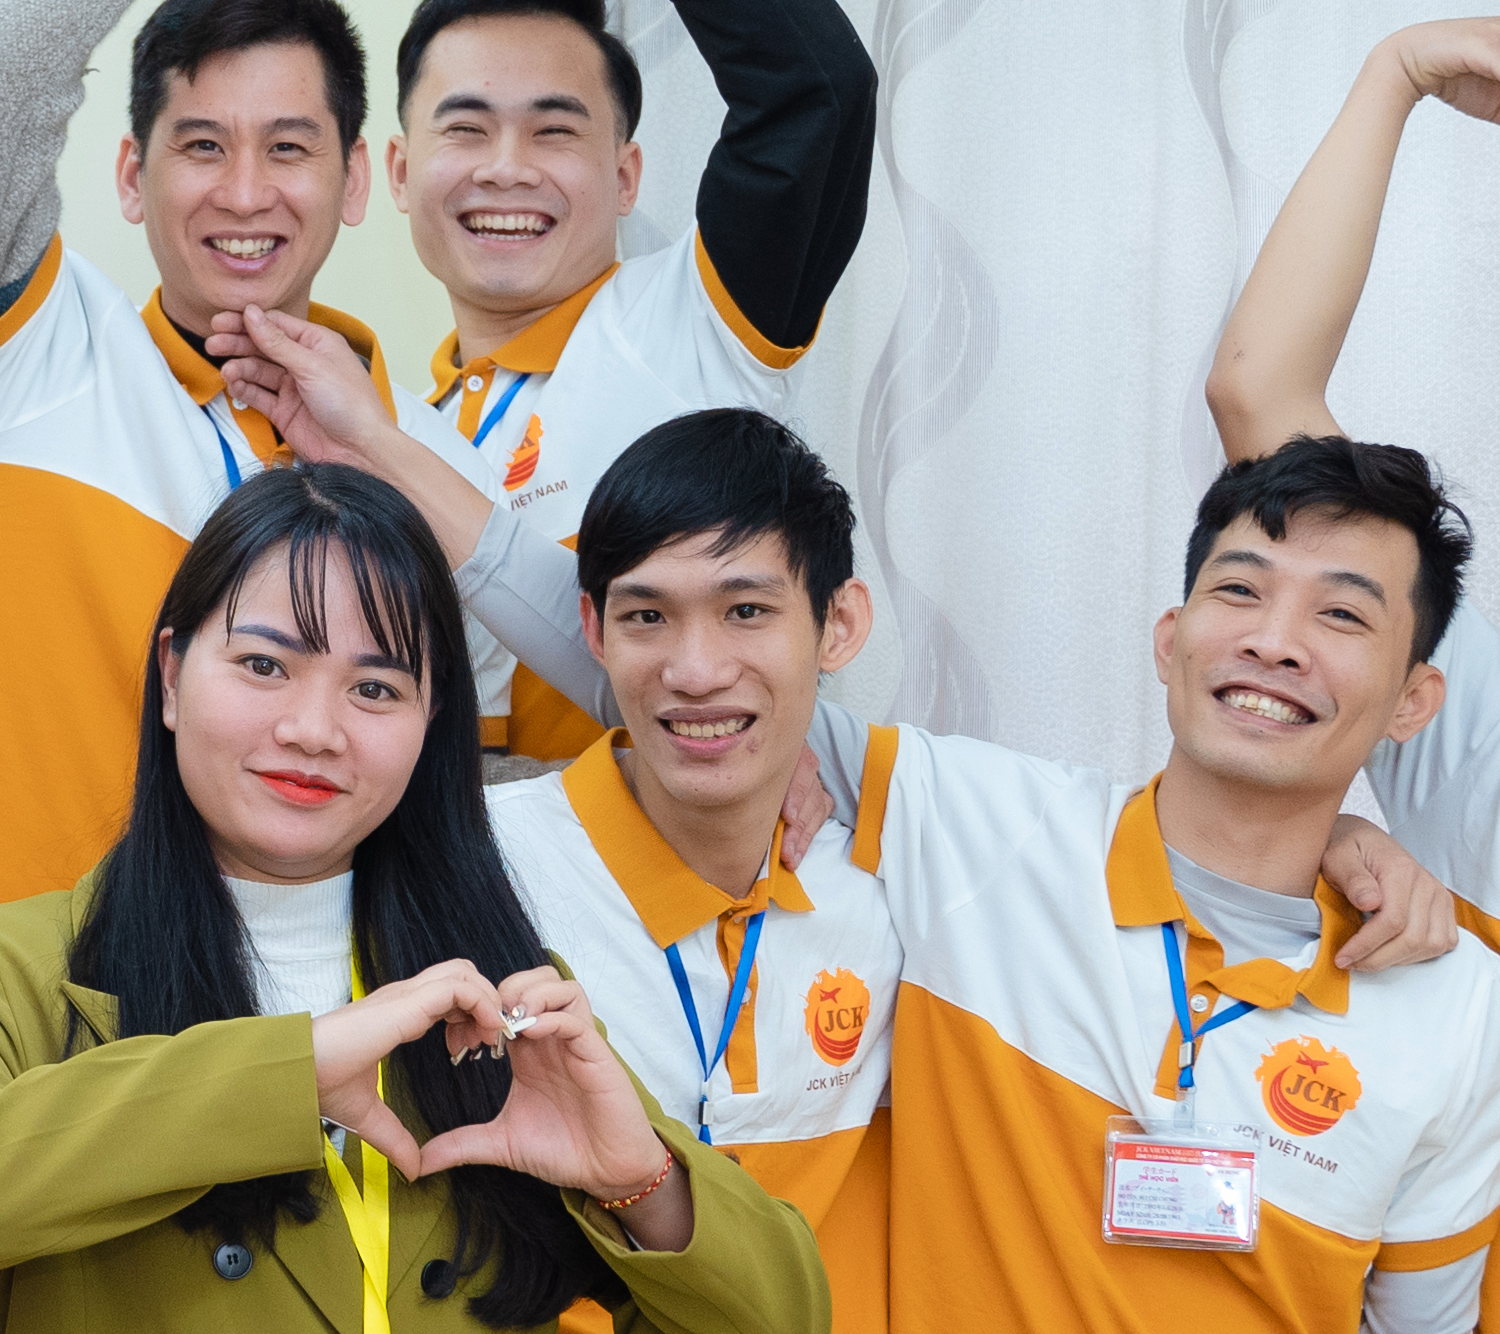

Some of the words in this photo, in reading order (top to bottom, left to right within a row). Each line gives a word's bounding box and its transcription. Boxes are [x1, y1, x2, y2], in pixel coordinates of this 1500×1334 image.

[535, 480, 568, 499] NAM
[824, 1005, 864, 1033] JCK
[806, 1077, 827, 1091] JCK
[1285, 1074, 1347, 1113] JCK
[1233, 1123, 1264, 1140] JCK
[1268, 1135, 1301, 1157] VIỆT
[1303, 1150, 1339, 1174] NAM
